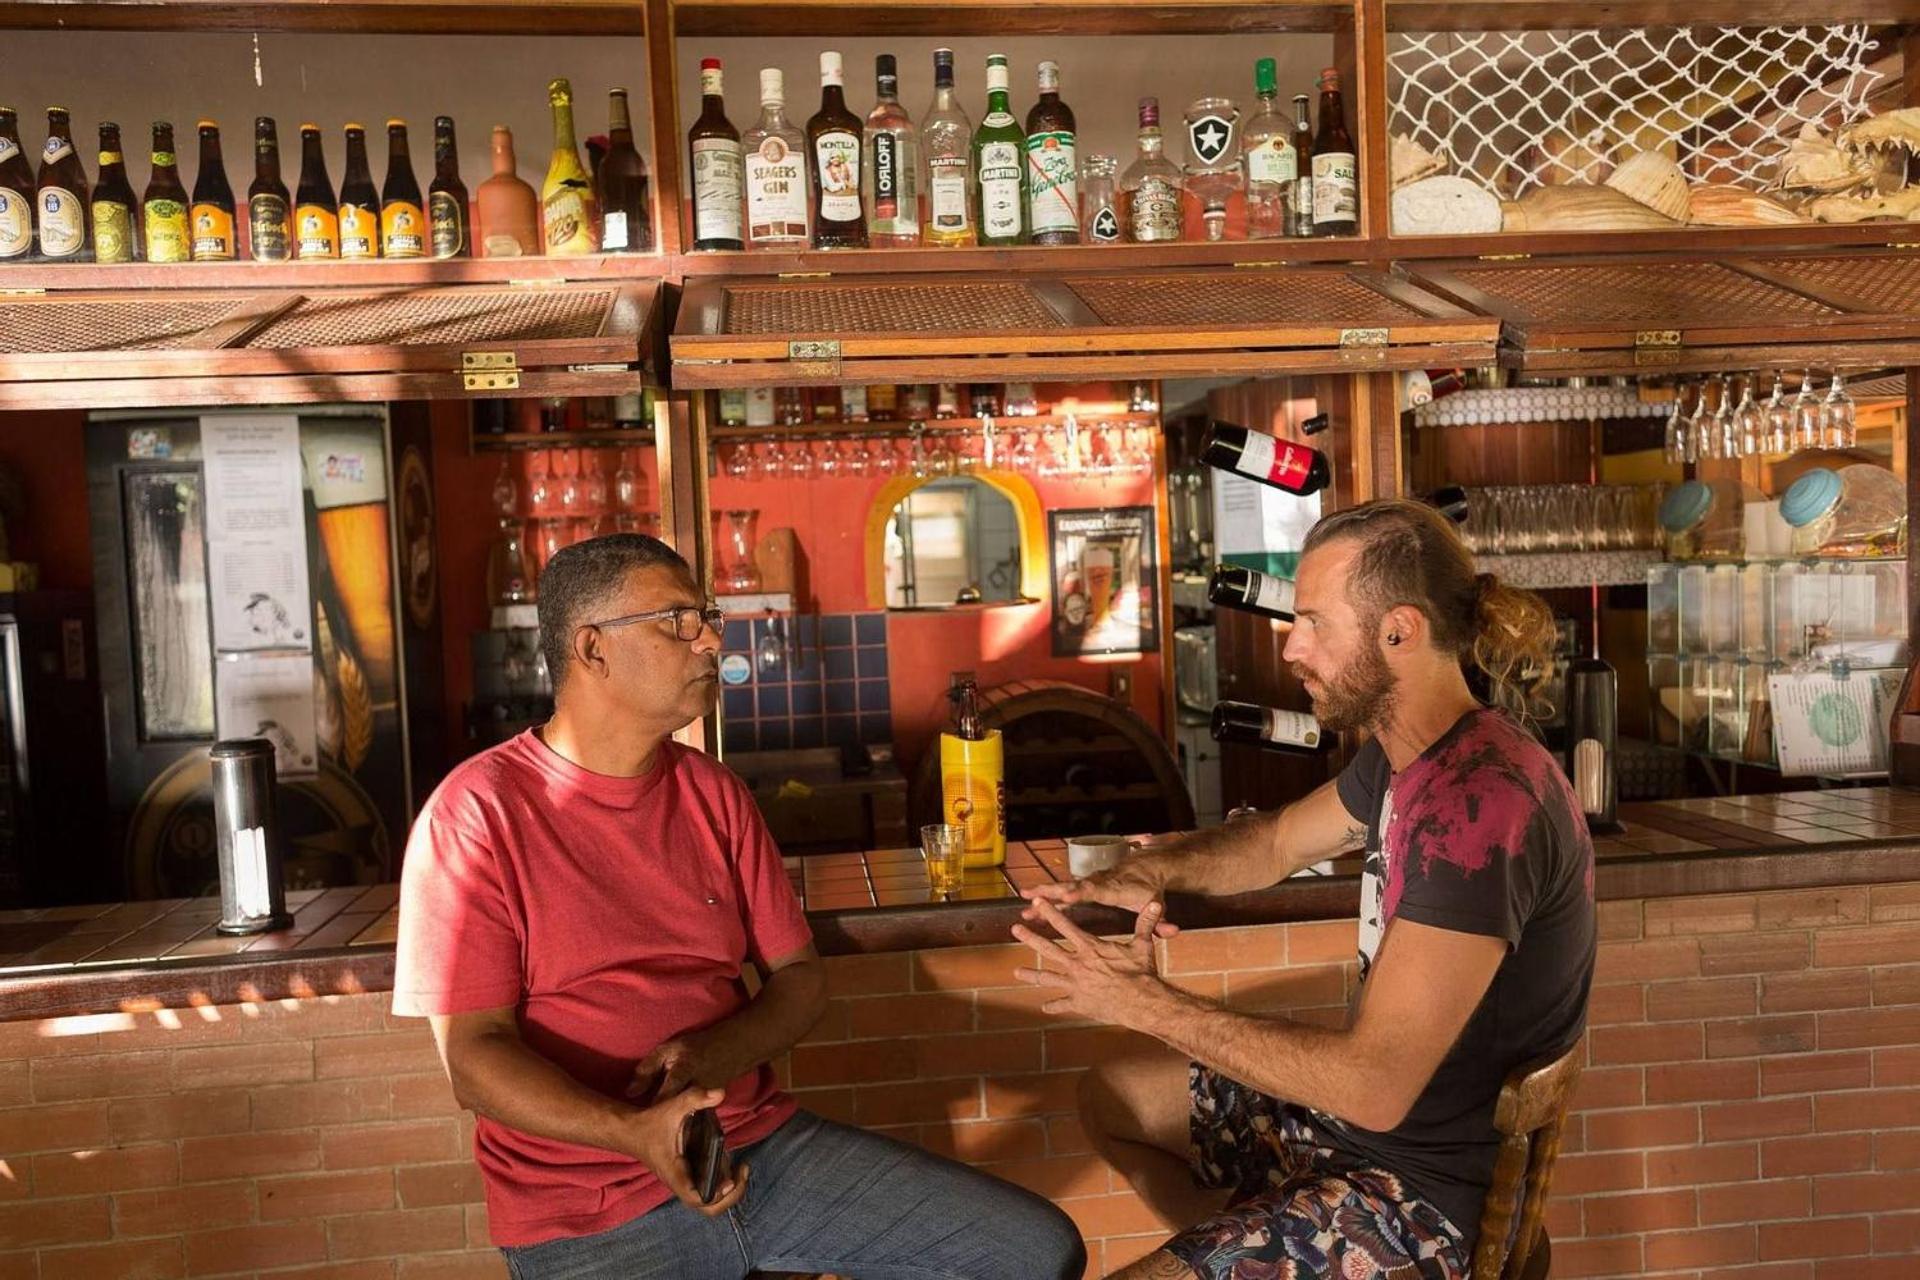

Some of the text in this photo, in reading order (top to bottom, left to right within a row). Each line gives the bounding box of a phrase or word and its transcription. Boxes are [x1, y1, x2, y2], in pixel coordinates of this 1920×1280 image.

[820, 141, 855, 150] MONTILLA
[930, 158, 967, 167] MARTINI
[754, 166, 797, 180] SEAGERS
[983, 168, 1018, 180] MARTINI
[763, 181, 789, 194] GIN
